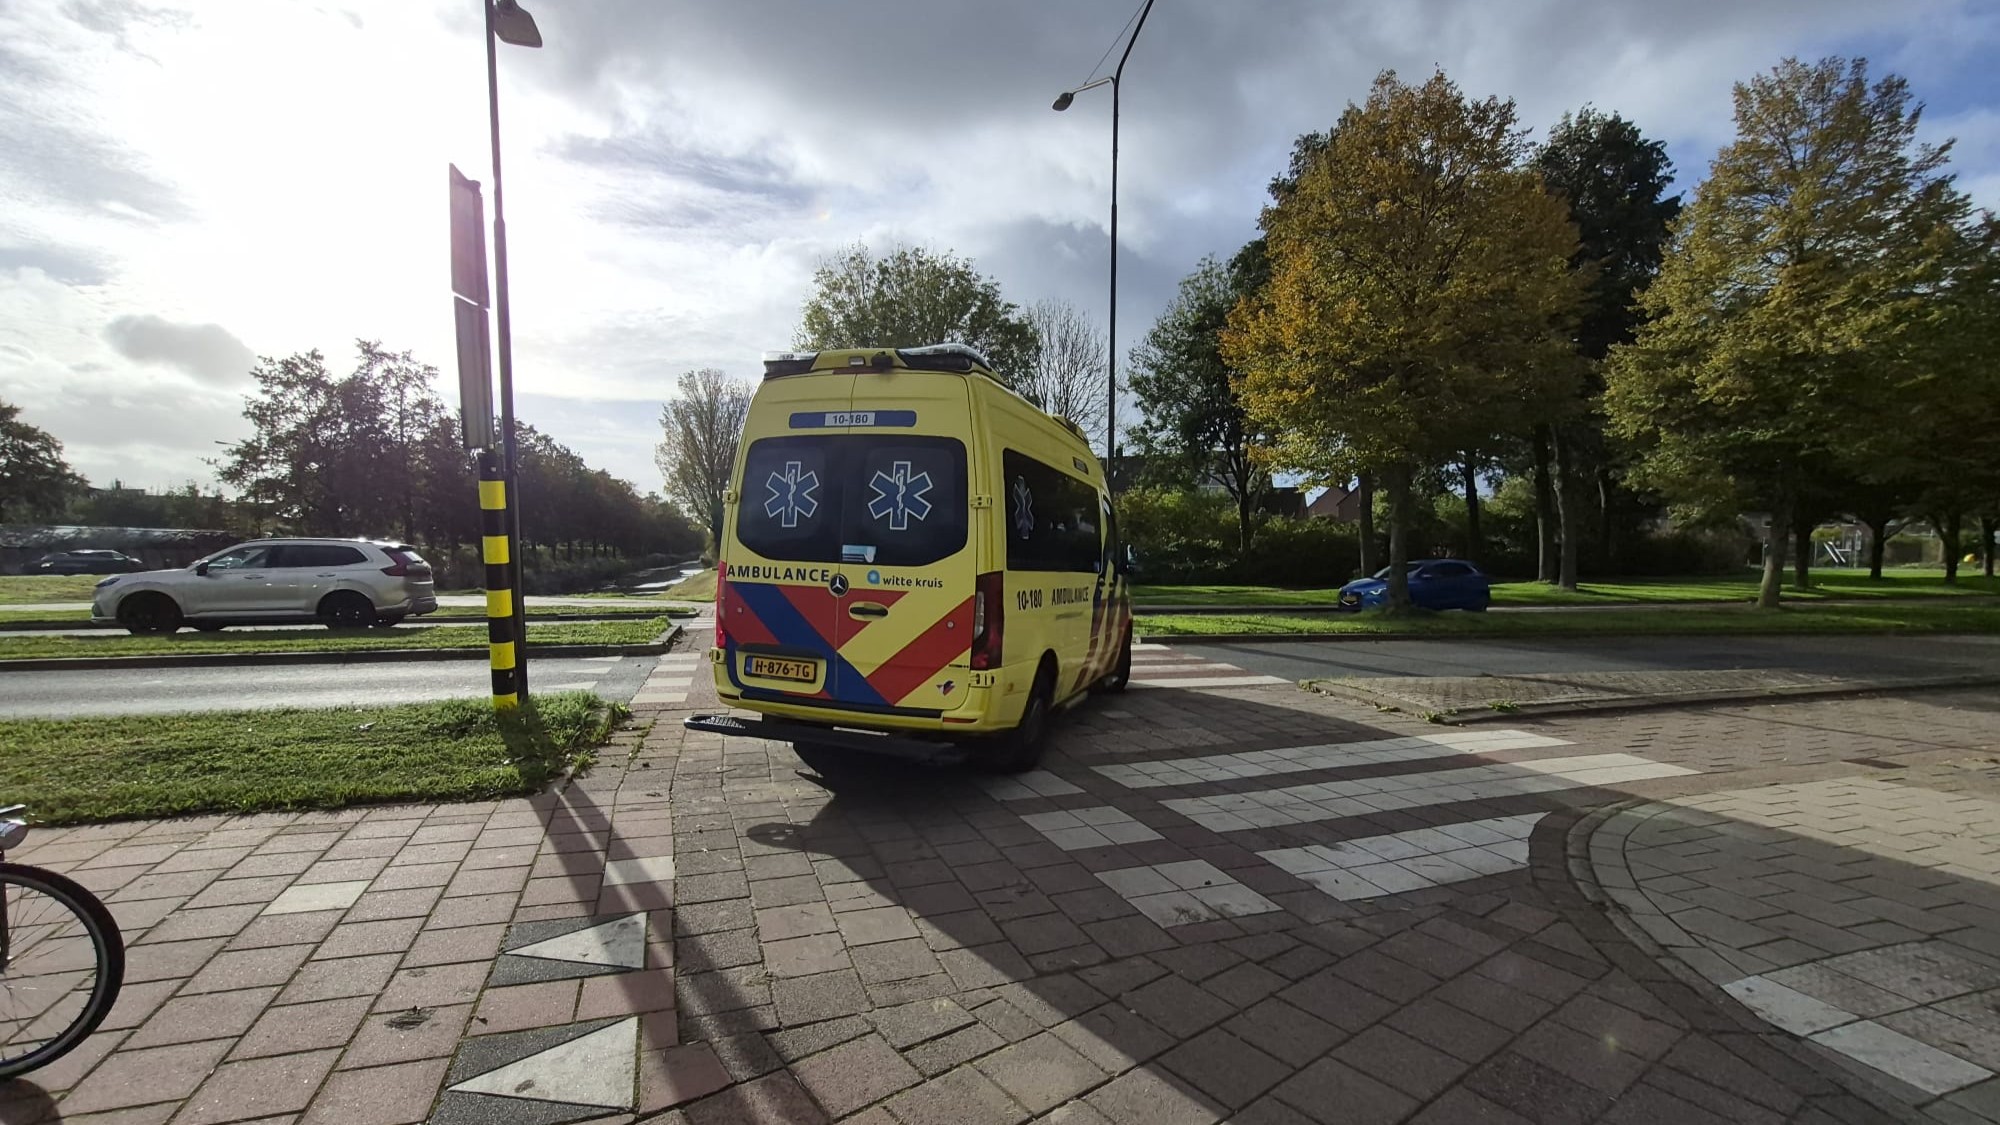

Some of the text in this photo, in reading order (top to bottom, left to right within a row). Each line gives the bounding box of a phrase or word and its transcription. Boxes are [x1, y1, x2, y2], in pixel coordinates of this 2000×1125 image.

[832, 414, 869, 424] 10-180
[727, 565, 830, 582] AMBULANCE
[882, 575, 943, 588] witte kruis
[1016, 588, 1042, 611] 10-180
[755, 660, 810, 677] H-876-TG
